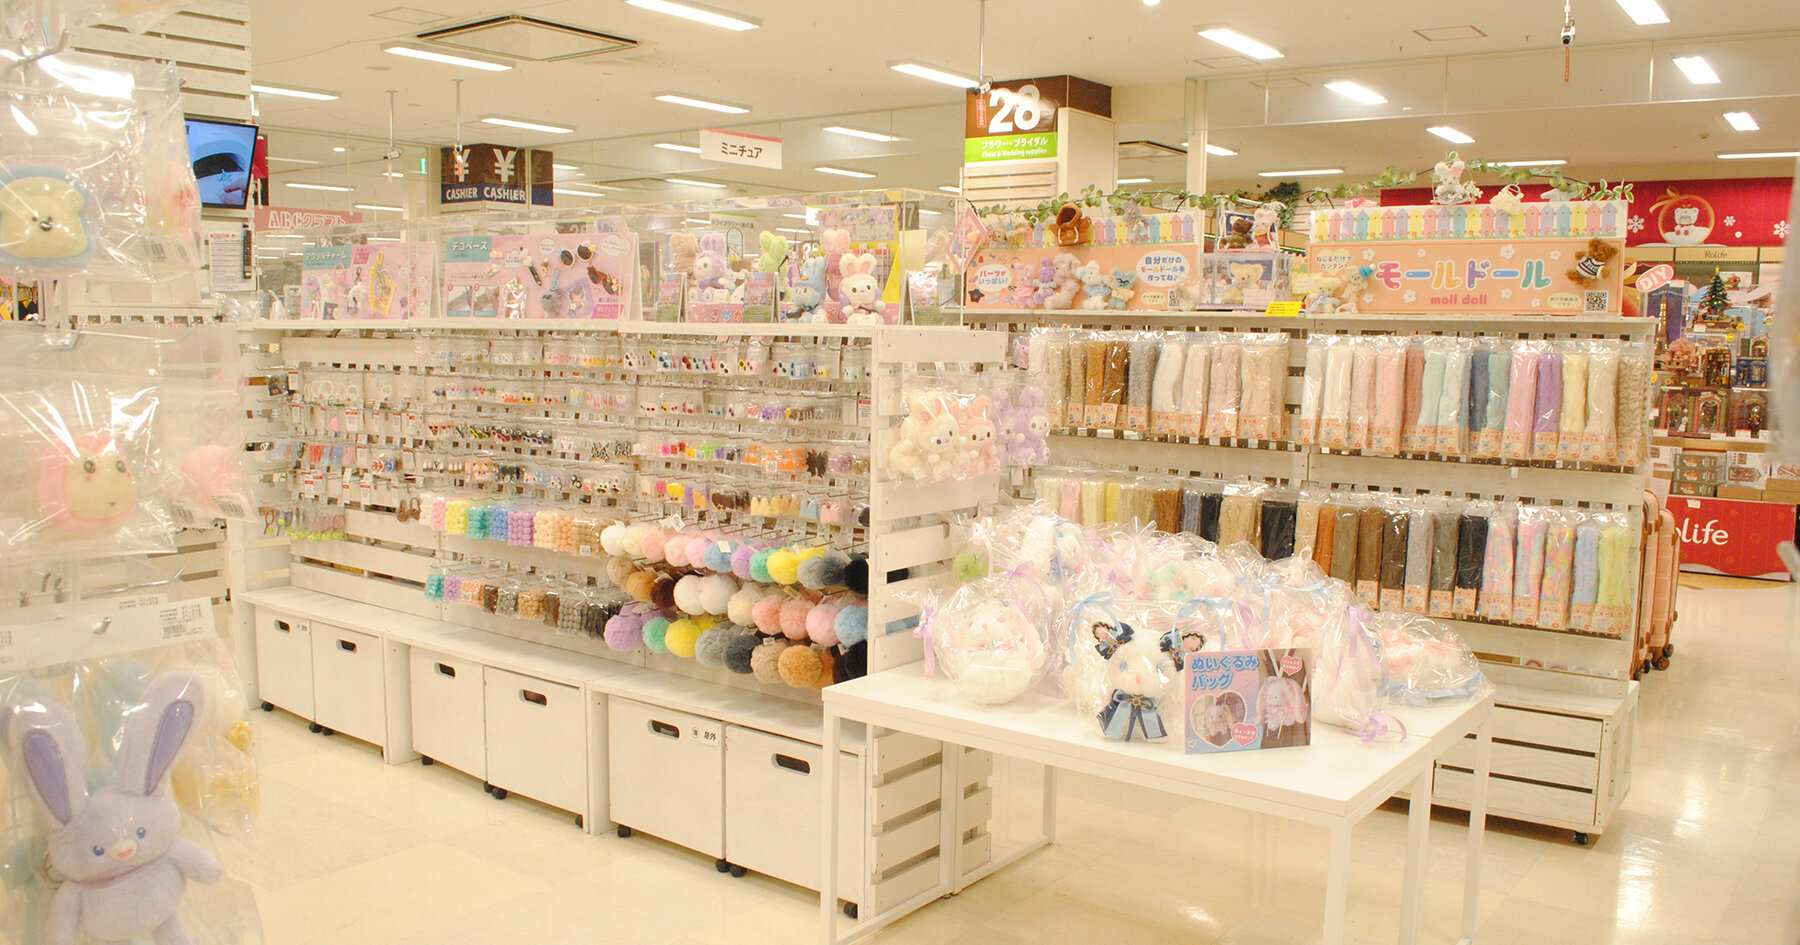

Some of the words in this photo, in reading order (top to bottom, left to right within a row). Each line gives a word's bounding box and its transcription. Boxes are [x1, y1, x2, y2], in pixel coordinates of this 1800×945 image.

[988, 84, 1041, 134] 28
[721, 141, 763, 159] ミニチュア
[981, 136, 1049, 150] フラワー・ブライダル
[1001, 148, 1025, 157] Wedding
[1025, 147, 1048, 156] supplies
[446, 187, 478, 200] CASHIER
[483, 186, 526, 201] CASHIER
[268, 210, 347, 229] ABCクラフト
[1145, 256, 1182, 265] 自分だけの
[1704, 249, 1728, 258] Rolife
[979, 269, 1007, 278] パーツが
[1140, 265, 1186, 273] モールドールを
[1376, 258, 1552, 291] モールドール
[1638, 266, 1669, 291] DIY
[1430, 294, 1458, 305] moll
[1461, 294, 1487, 305] doll
[1191, 654, 1259, 671] ぬいぐるみ
[1191, 672, 1235, 691] バッグ
